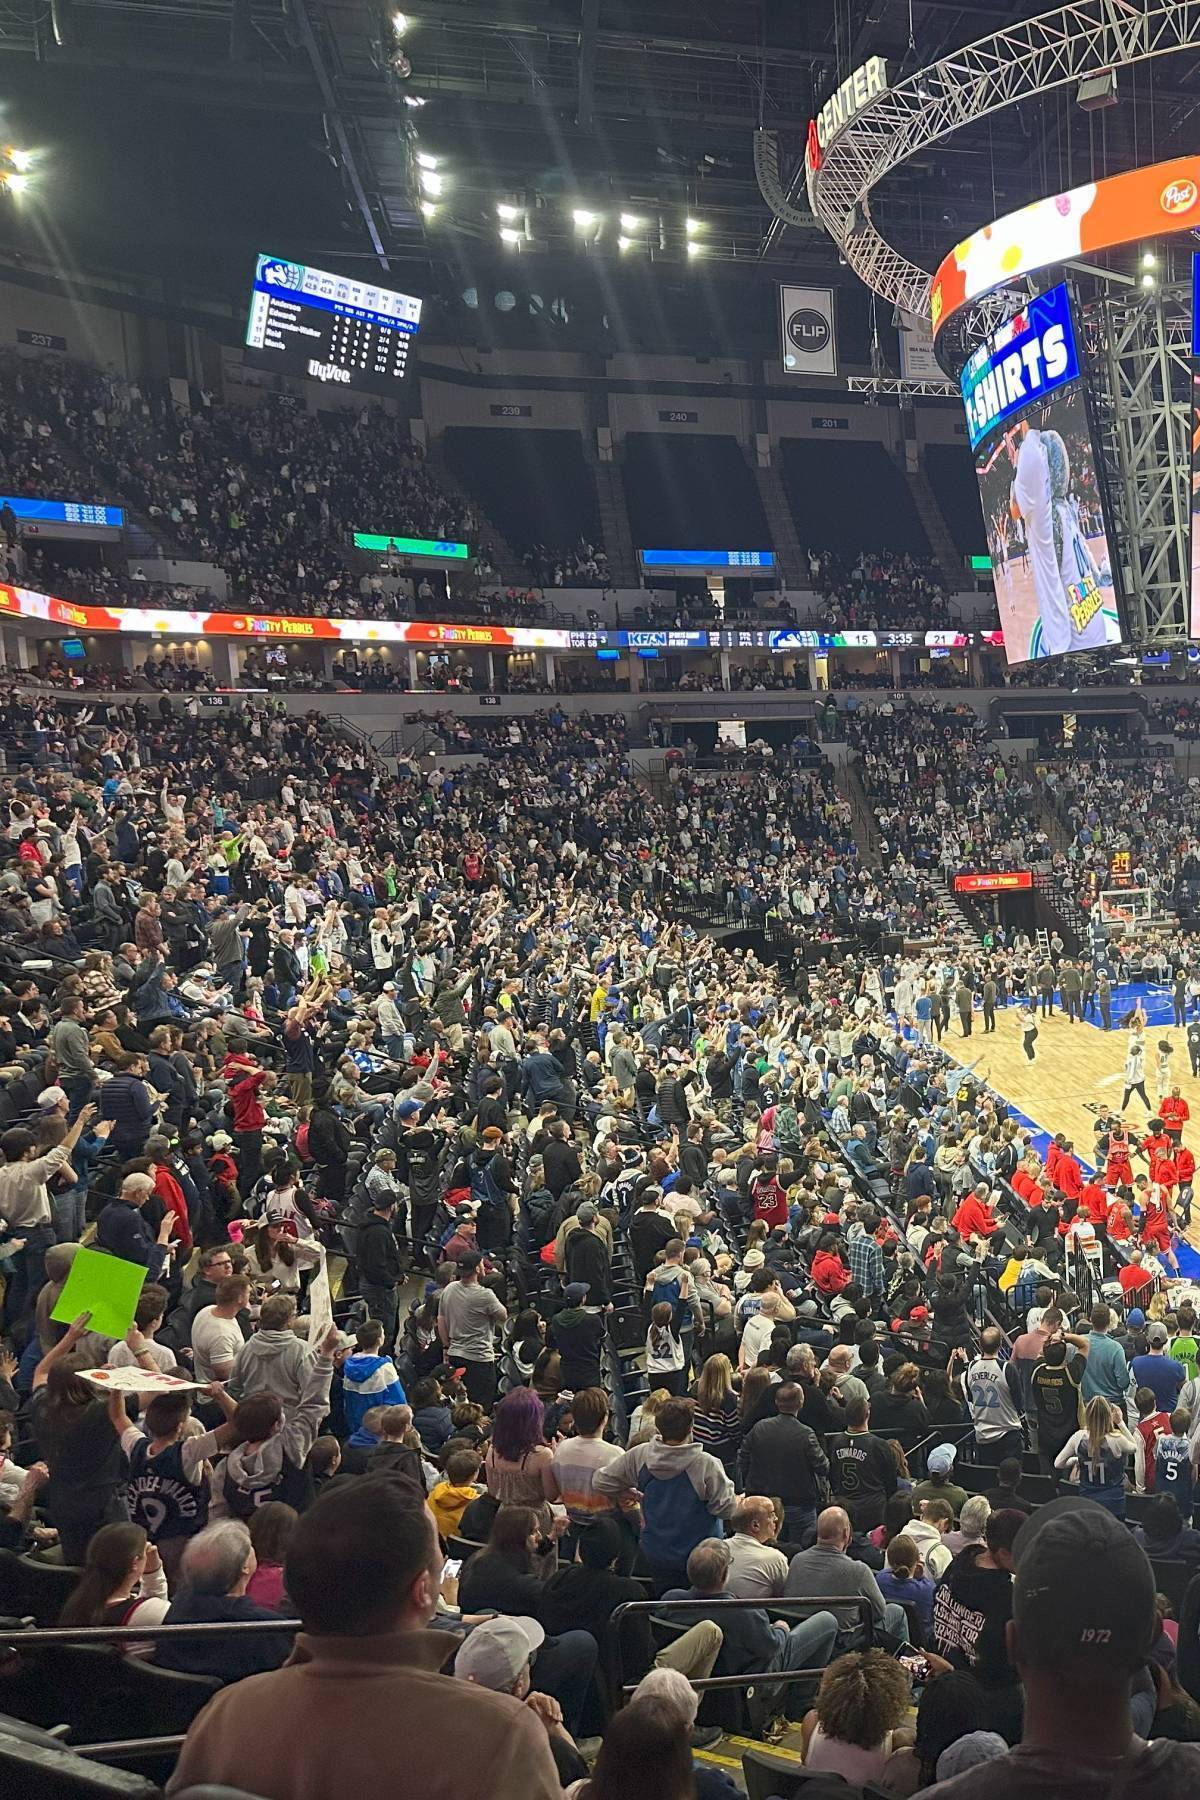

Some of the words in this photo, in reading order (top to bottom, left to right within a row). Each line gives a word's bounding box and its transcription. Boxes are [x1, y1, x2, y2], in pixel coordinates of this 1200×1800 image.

[817, 55, 882, 148] CENTER
[1166, 184, 1192, 208] Post
[270, 298, 301, 312] Anderson
[269, 308, 296, 321] Edwards
[266, 328, 281, 338] Reid
[793, 323, 826, 338] FLIP
[31, 333, 53, 347] 237
[502, 406, 520, 416] 239
[669, 412, 688, 422] 240
[822, 419, 838, 429] 201
[282, 618, 314, 634] PEBBLES
[587, 640, 597, 648] 58
[628, 633, 667, 646] KFAN
[855, 635, 868, 644] 15
[888, 633, 913, 644] 3:35
[934, 635, 946, 644] 21
[208, 697, 222, 705] 136
[1112, 860, 1129, 872] 24
[758, 1193, 777, 1208] 23
[971, 1371, 998, 1383] BEVERLEY
[971, 1385, 1000, 1408] 22
[1042, 1387, 1063, 1414] 5
[836, 1447, 867, 1461] EDWARDS
[1161, 1450, 1185, 1463] EDWARDS
[842, 1463, 859, 1490] 5
[1083, 1461, 1105, 1484] 11
[1166, 1462, 1178, 1481] 5
[141, 1498, 166, 1534] 9
[961, 1625, 978, 1643] FOR
[1080, 1628, 1111, 1643] 1972
